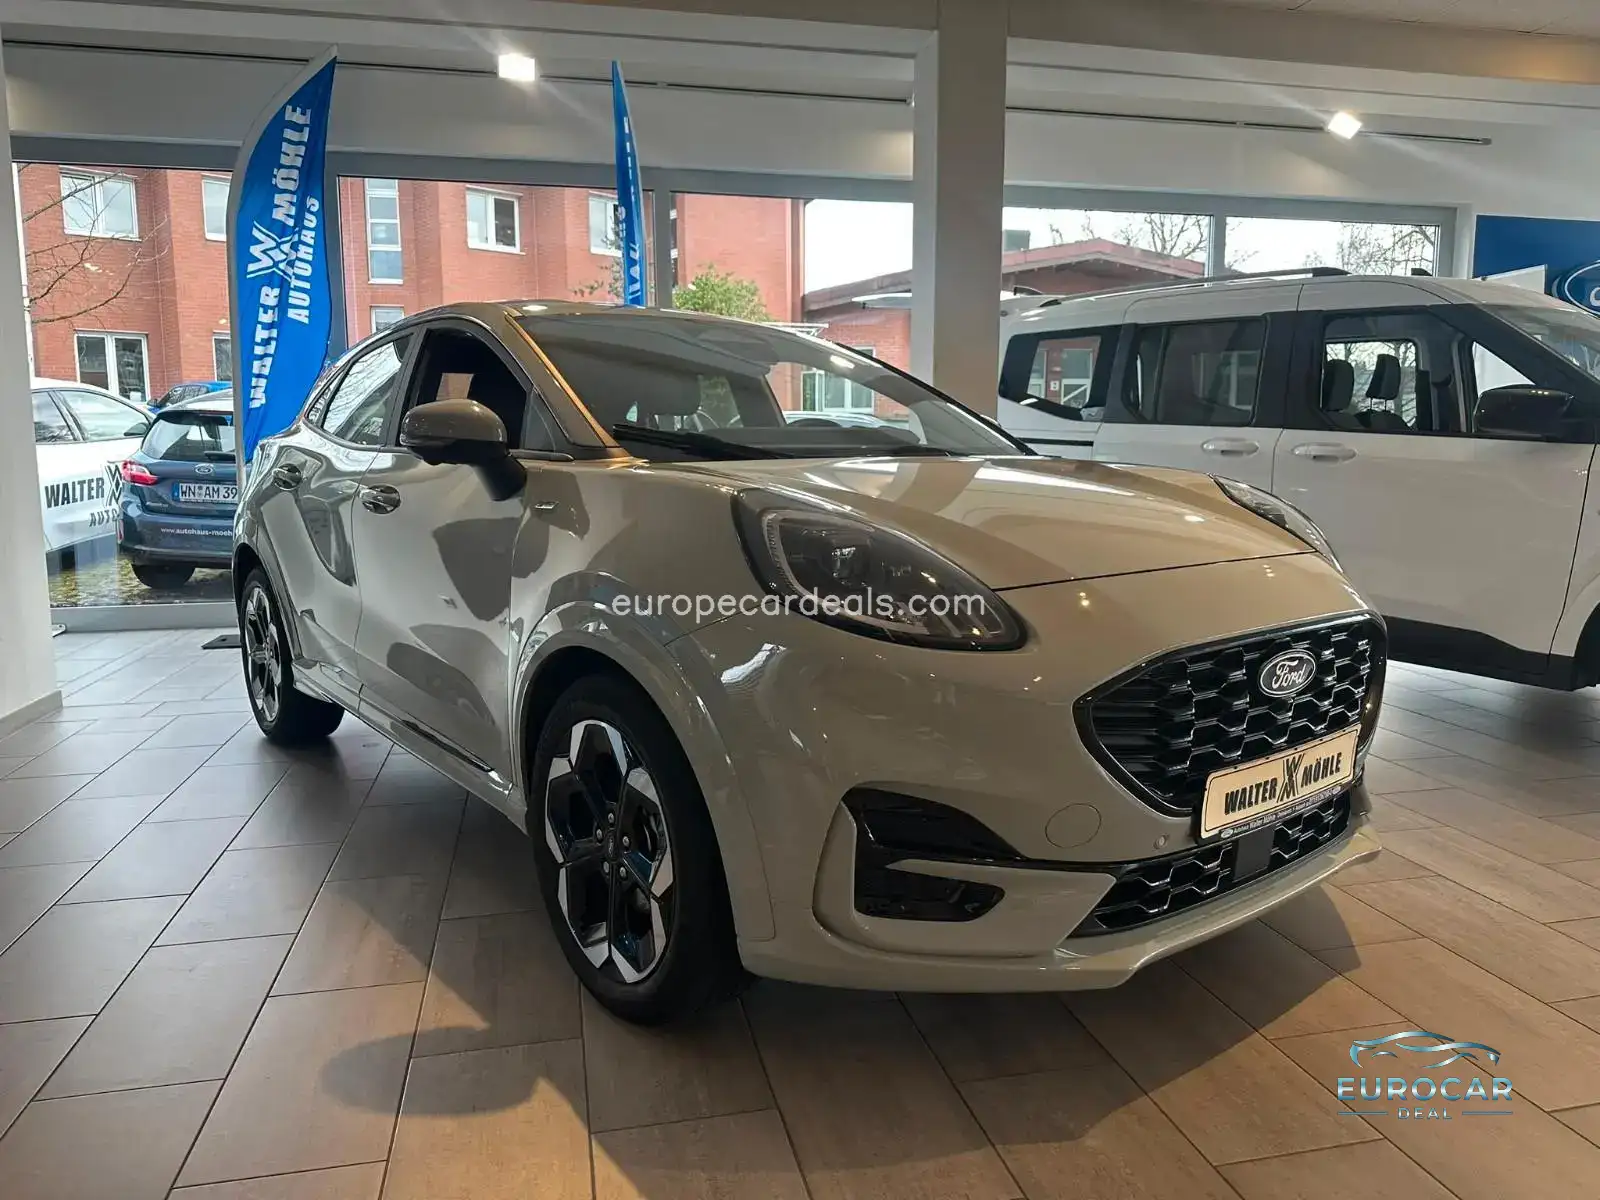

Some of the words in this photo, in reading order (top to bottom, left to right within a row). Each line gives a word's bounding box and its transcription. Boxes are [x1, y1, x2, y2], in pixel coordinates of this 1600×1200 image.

[250, 285, 280, 407] WALTER
[271, 104, 312, 228] MÖHLE
[287, 194, 322, 325] AUTOHAUS
[44, 477, 106, 509] WALTER
[203, 485, 221, 499] AM
[1272, 659, 1307, 690] Ford
[1224, 778, 1278, 815] WALTER
[1301, 752, 1342, 788] MÖHLE
